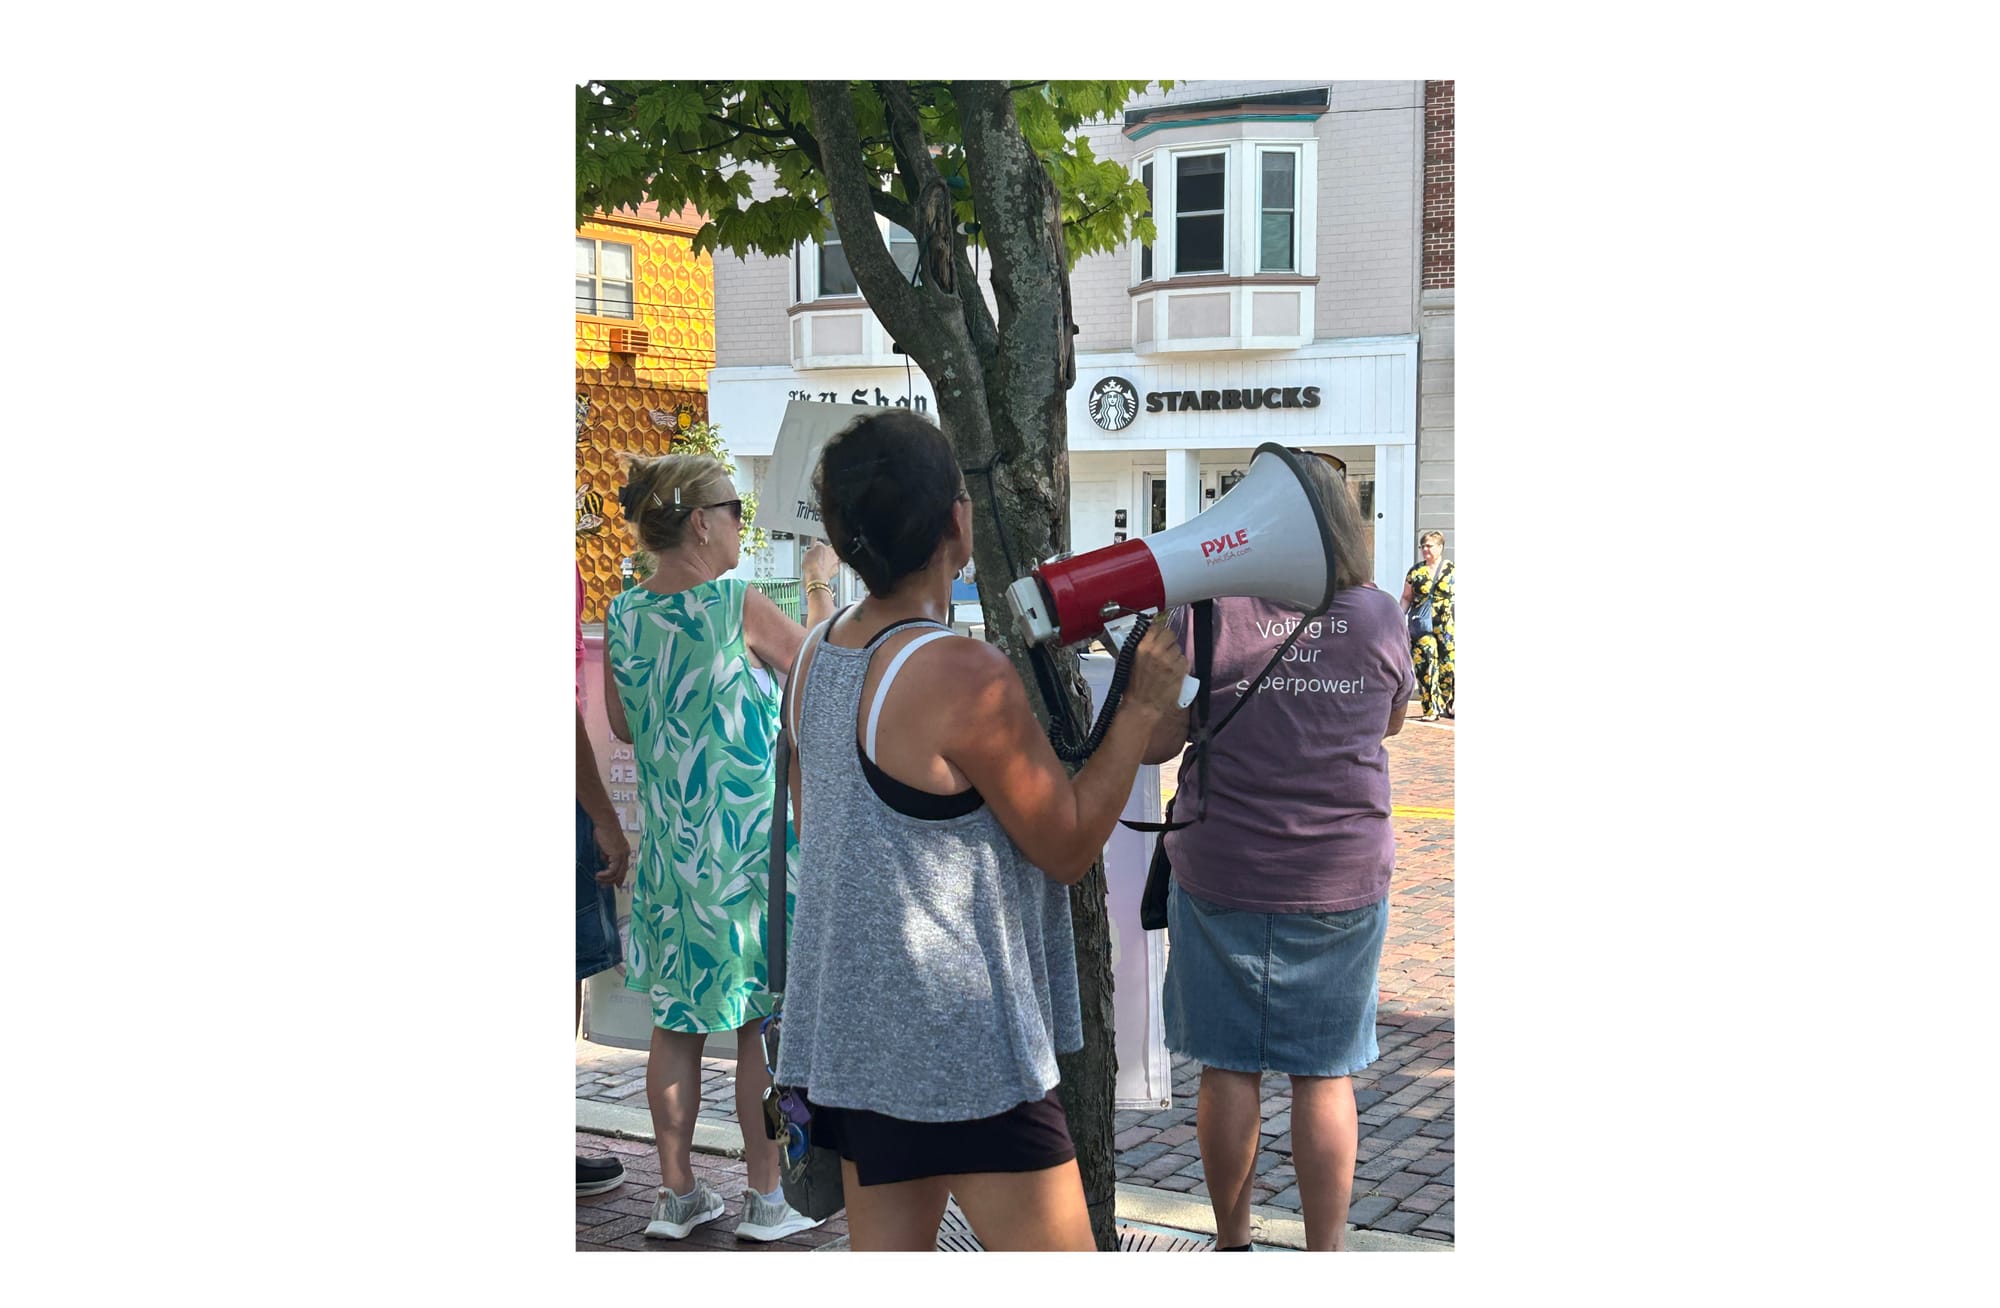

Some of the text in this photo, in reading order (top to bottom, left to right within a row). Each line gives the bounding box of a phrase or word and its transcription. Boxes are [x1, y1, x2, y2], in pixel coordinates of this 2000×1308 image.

[1146, 386, 1321, 413] STARBUCKS
[1331, 616, 1348, 634] is
[1235, 675, 1364, 697] Sperpower!
